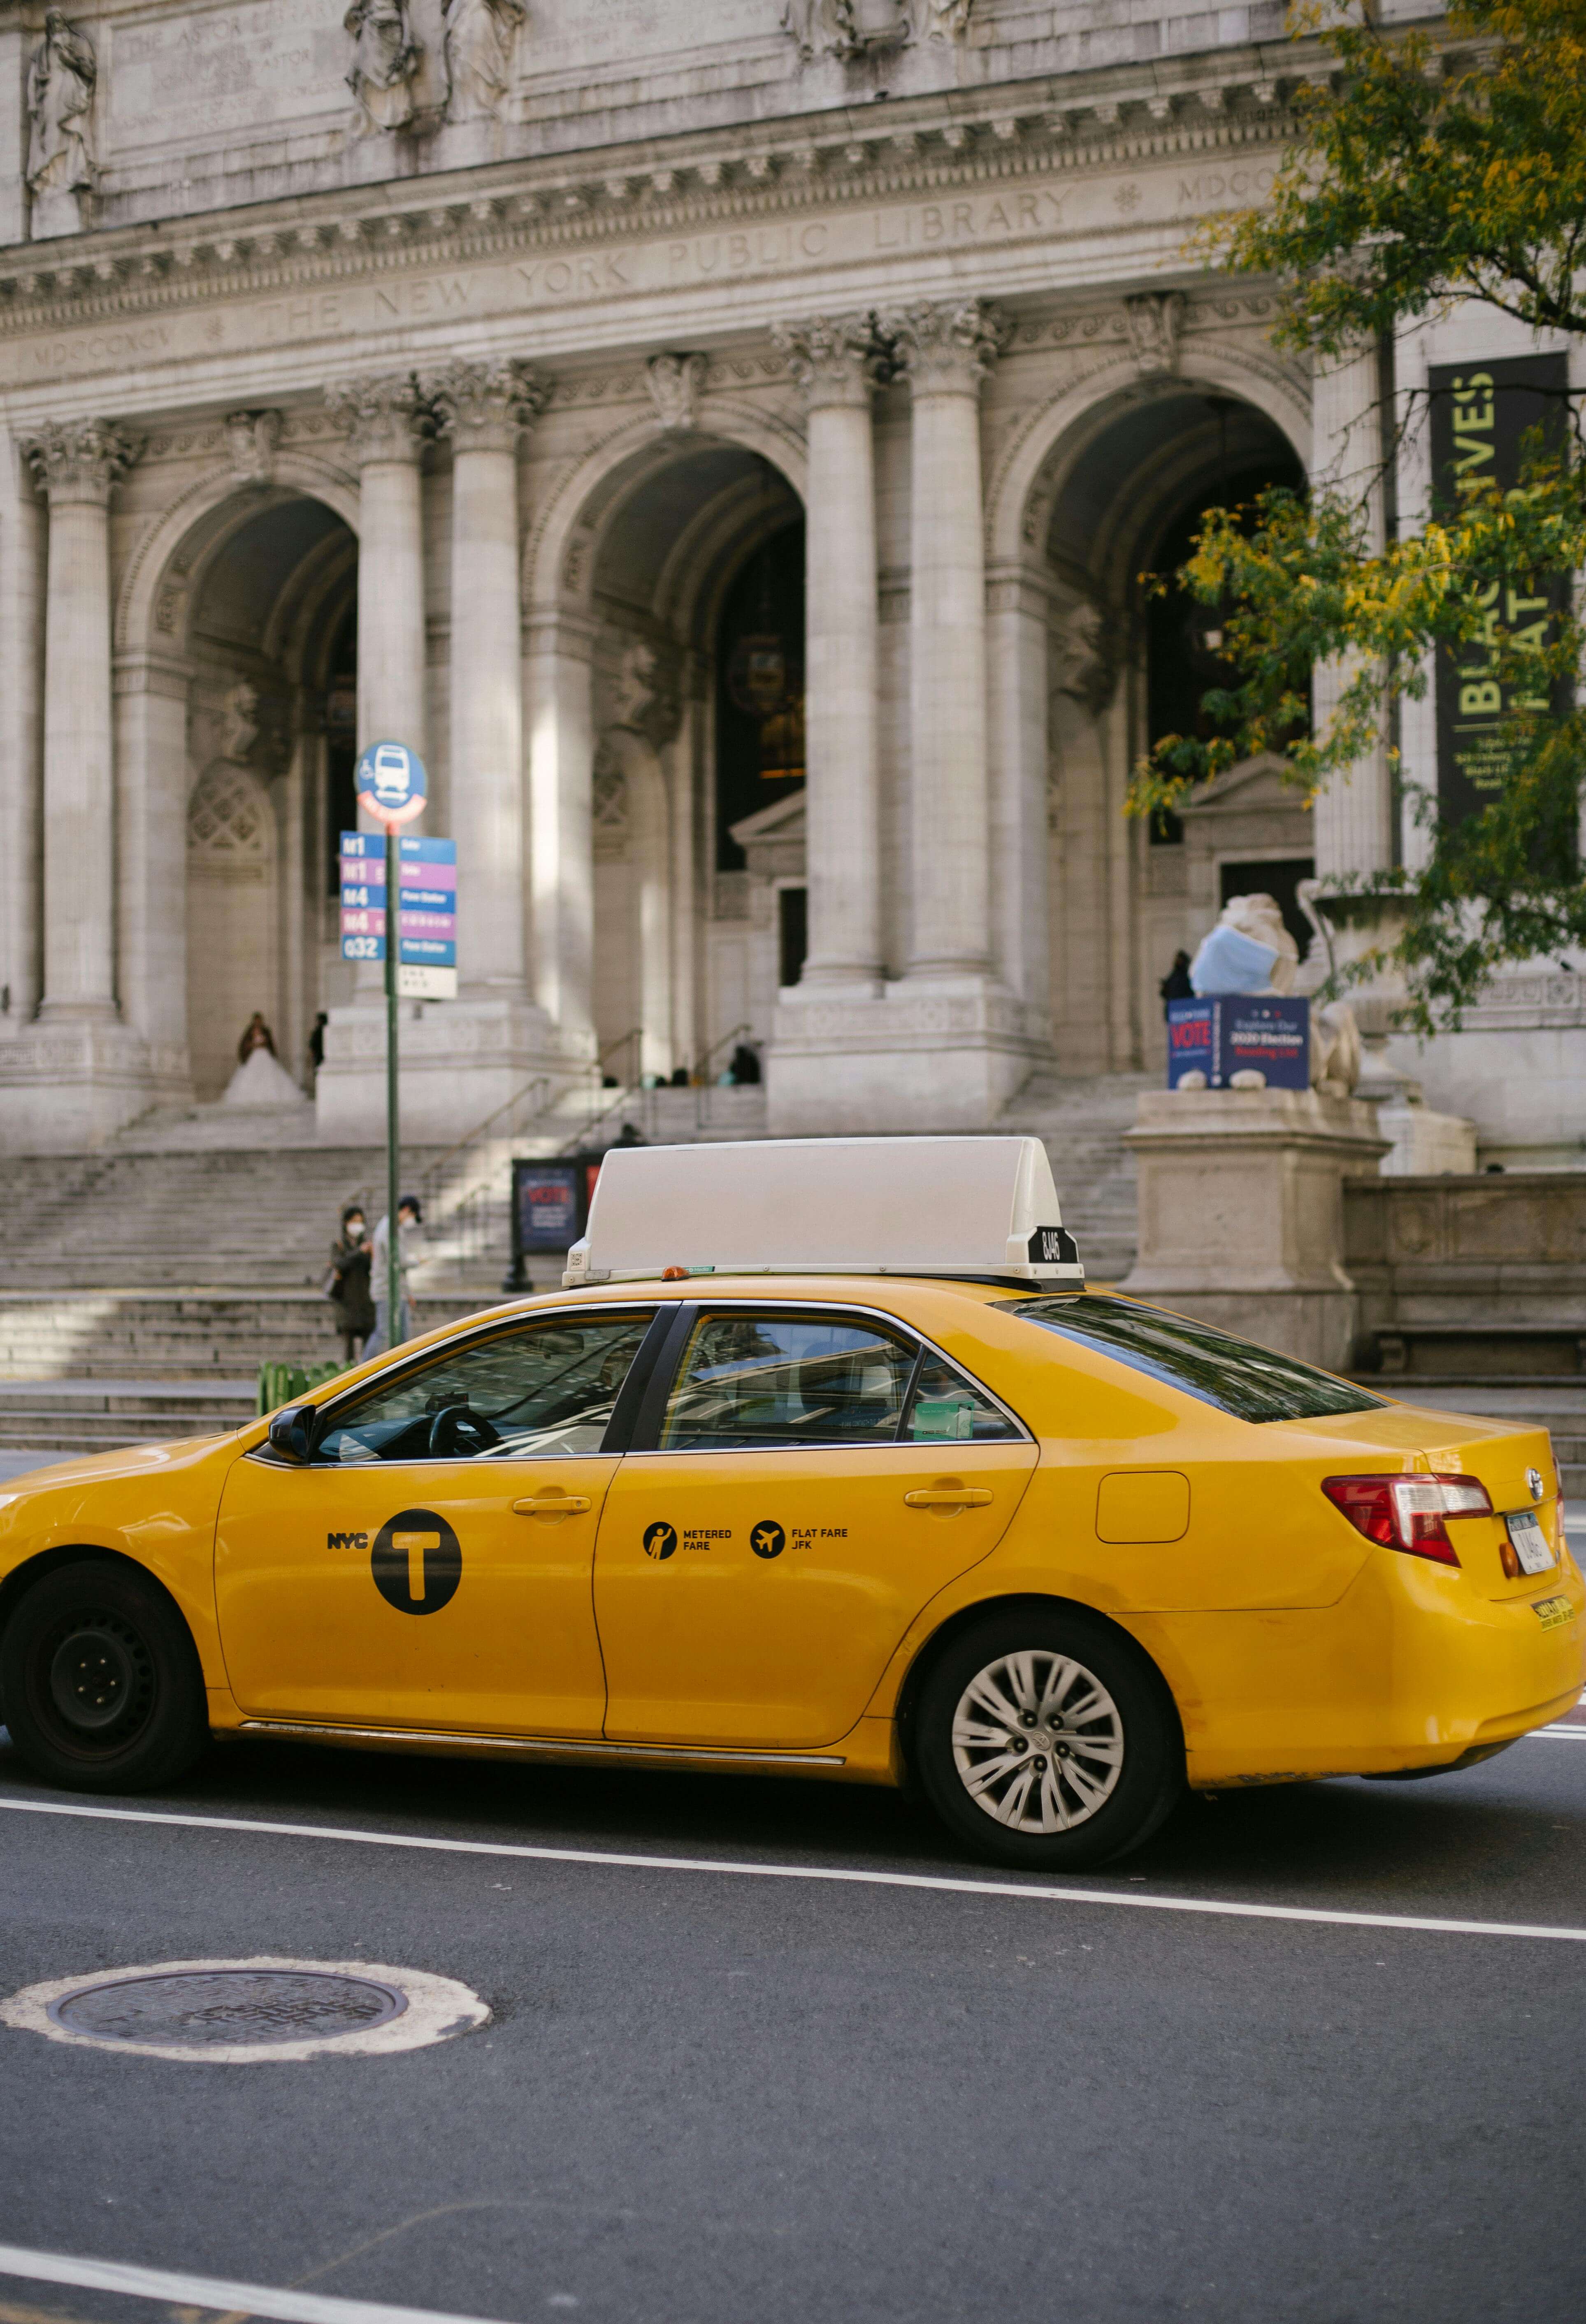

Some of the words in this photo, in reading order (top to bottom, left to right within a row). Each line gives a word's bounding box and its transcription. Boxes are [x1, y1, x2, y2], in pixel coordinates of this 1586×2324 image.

[258, 294, 340, 335] THE
[372, 273, 474, 319] NEW
[514, 252, 629, 298] YORK
[667, 223, 829, 277] PUBLIC
[873, 189, 1073, 249] LIBRARY
[1451, 372, 1497, 492] IVES
[343, 836, 365, 856] M1
[344, 886, 368, 906] M4
[1171, 1020, 1211, 1049] VOTE
[1261, 1033, 1303, 1047] Election
[1042, 1232, 1060, 1260] 8J46
[684, 1530, 731, 1538] METERED
[792, 1529, 817, 1537] FLAT
[821, 1529, 848, 1537] FARE
[684, 1542, 711, 1550] FARE
[792, 1541, 812, 1549] JFK
[327, 1533, 368, 1549] NYC
[392, 1532, 440, 1600] T
